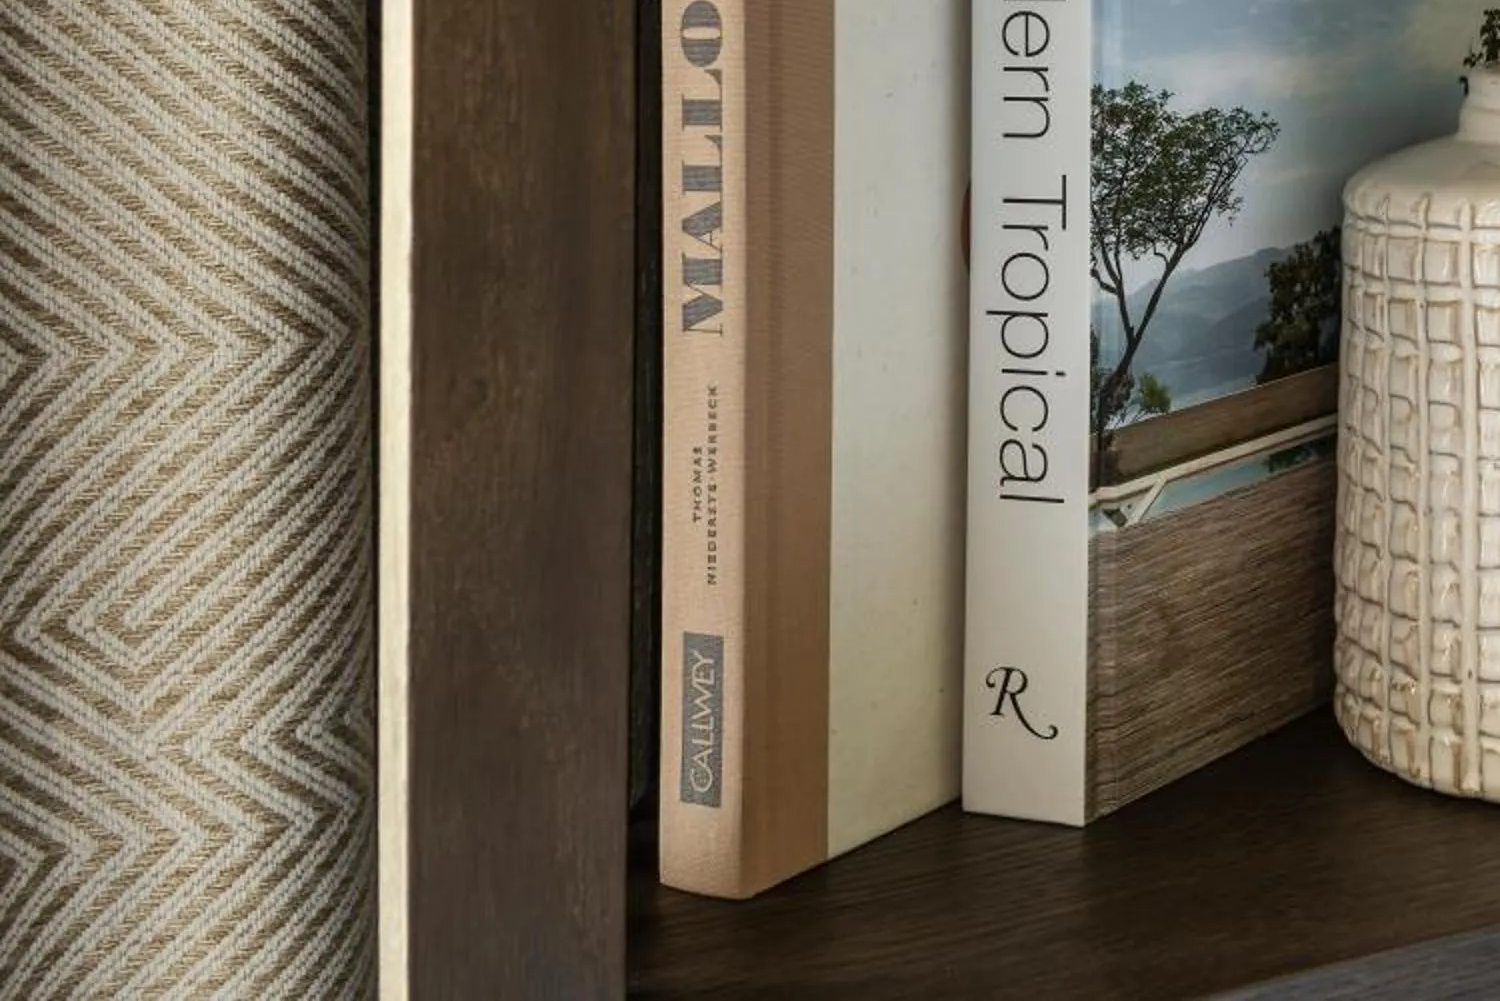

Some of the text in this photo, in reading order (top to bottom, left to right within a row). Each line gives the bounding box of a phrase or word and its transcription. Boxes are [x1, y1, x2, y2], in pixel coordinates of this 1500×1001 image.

[985, 174, 1067, 504] Tropical
[692, 445, 704, 524] THOMAS
[689, 650, 716, 793] CALLWEY
[985, 666, 1060, 741] R
